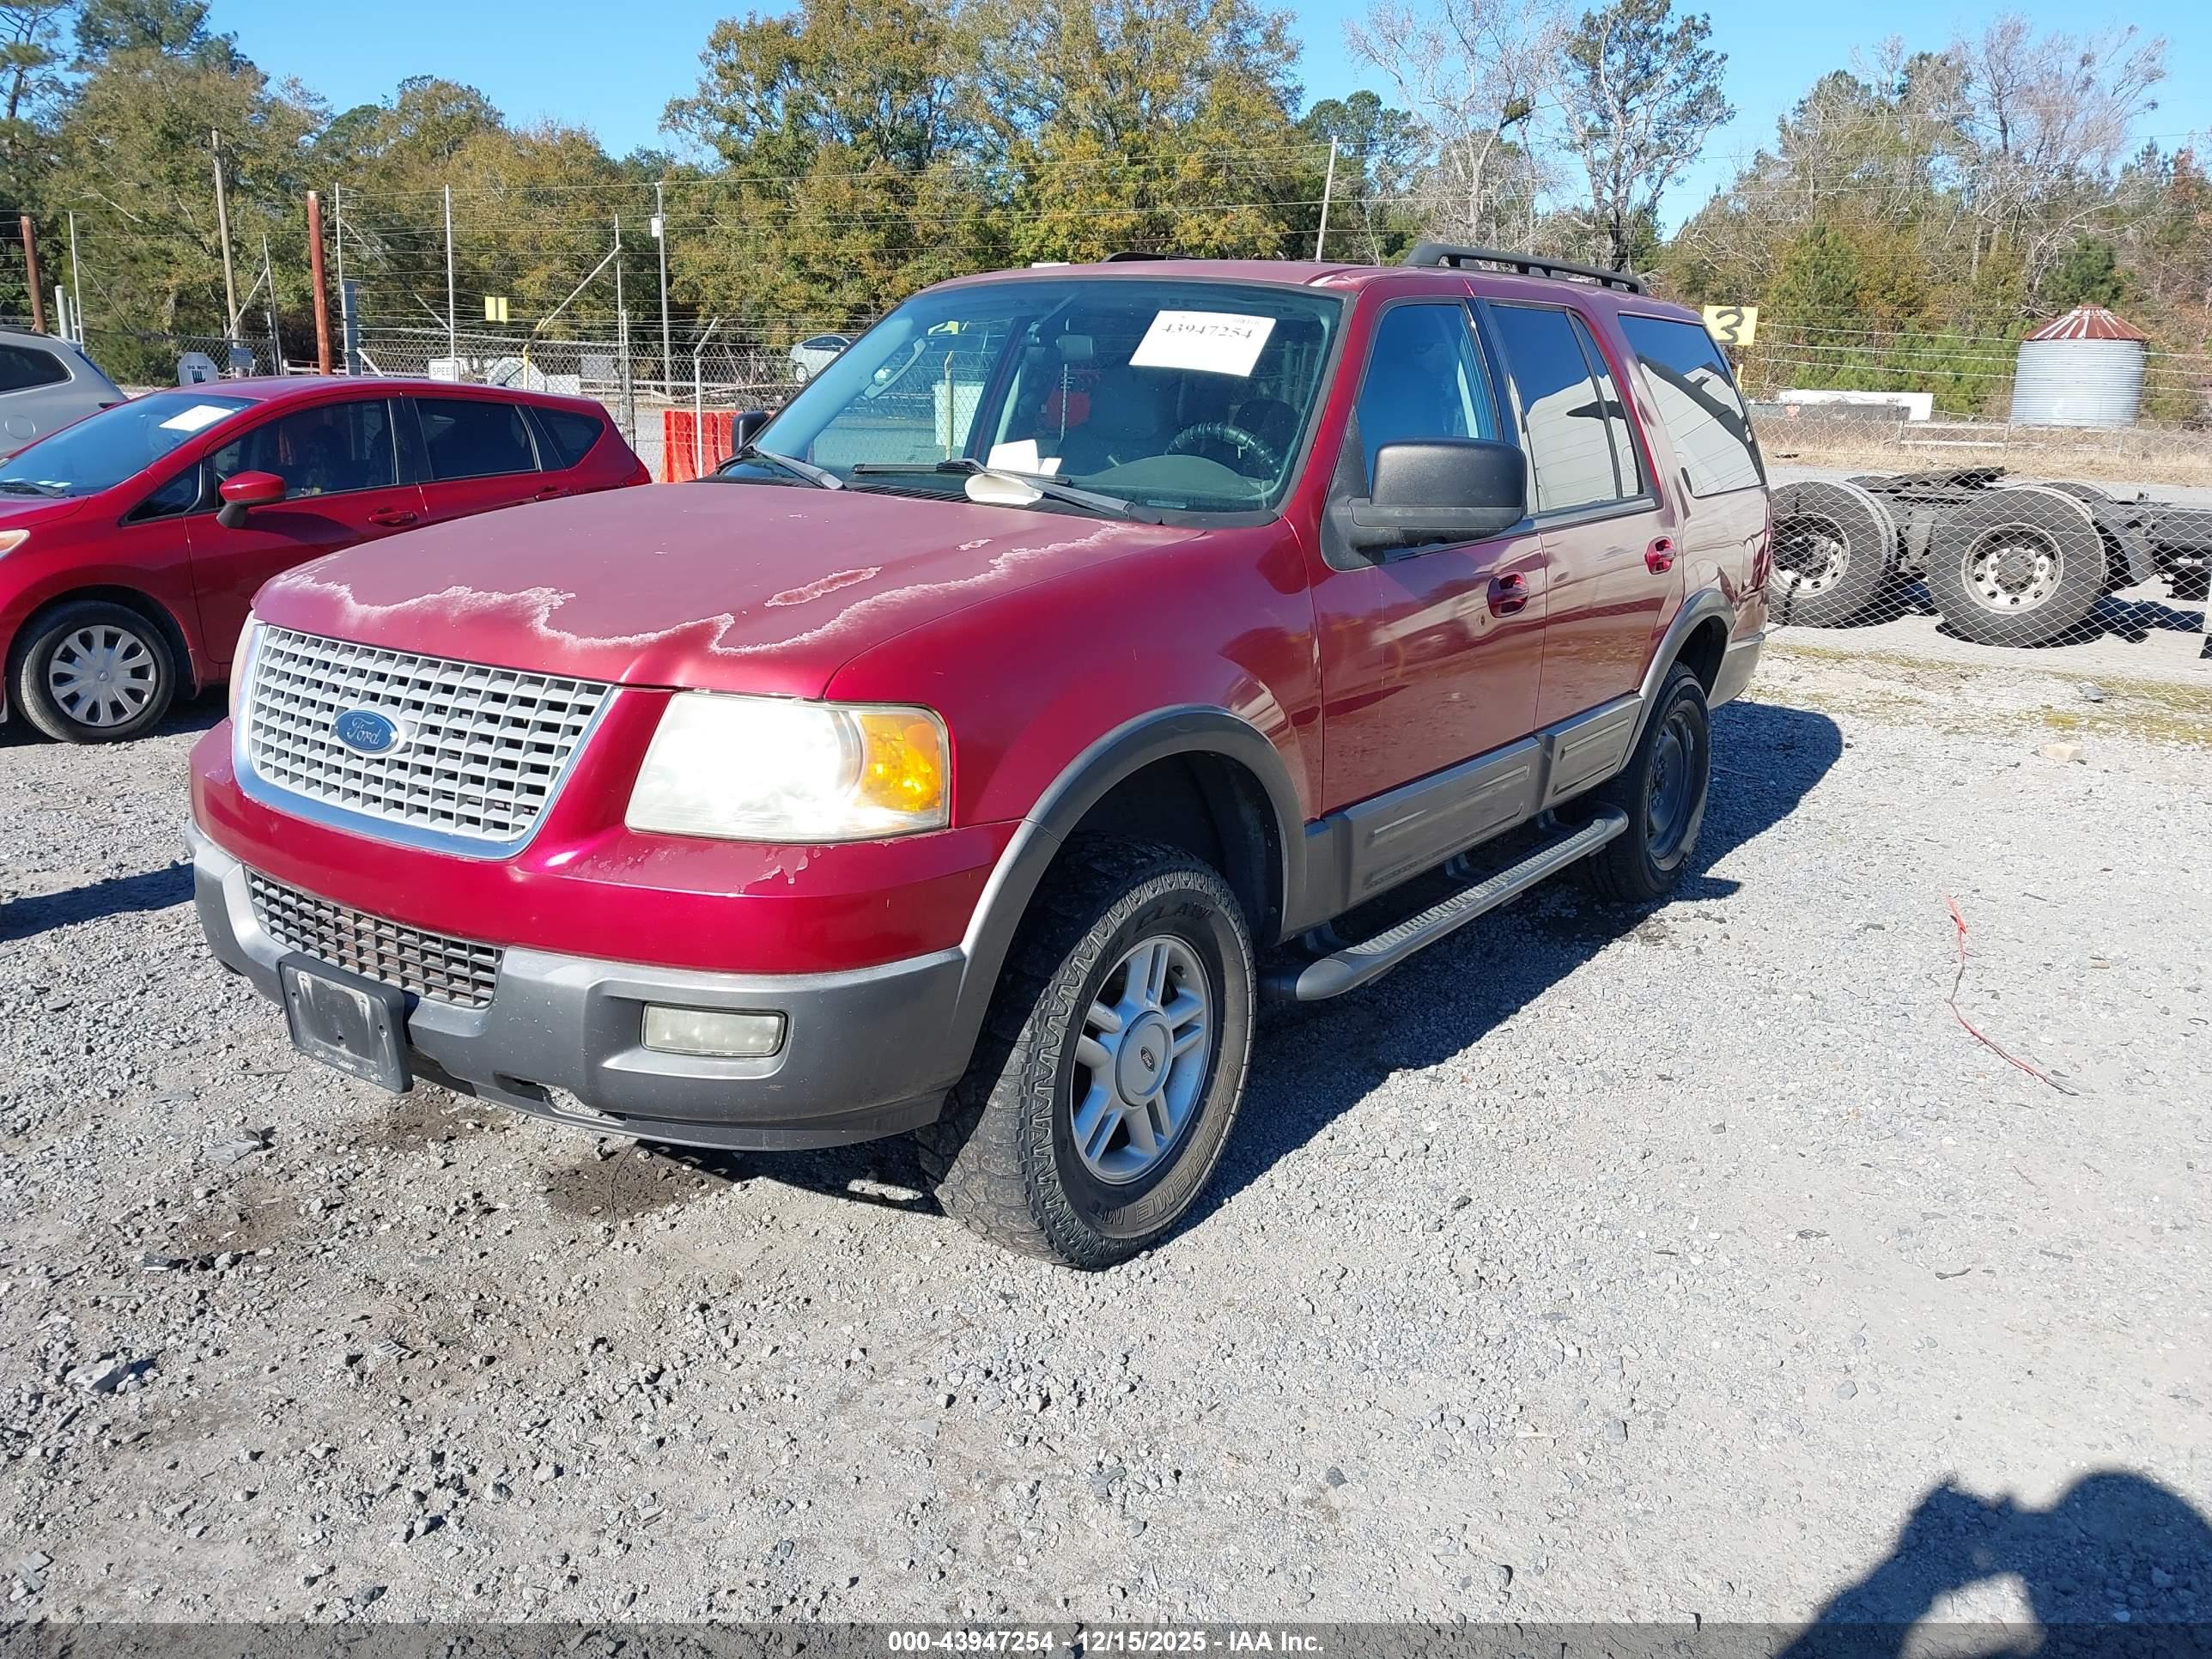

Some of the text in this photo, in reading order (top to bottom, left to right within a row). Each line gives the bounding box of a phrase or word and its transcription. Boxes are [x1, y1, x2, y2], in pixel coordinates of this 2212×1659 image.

[1716, 307, 1745, 344] 3
[346, 717, 382, 744] Ford
[1136, 1063, 1238, 1224] EXTREME
